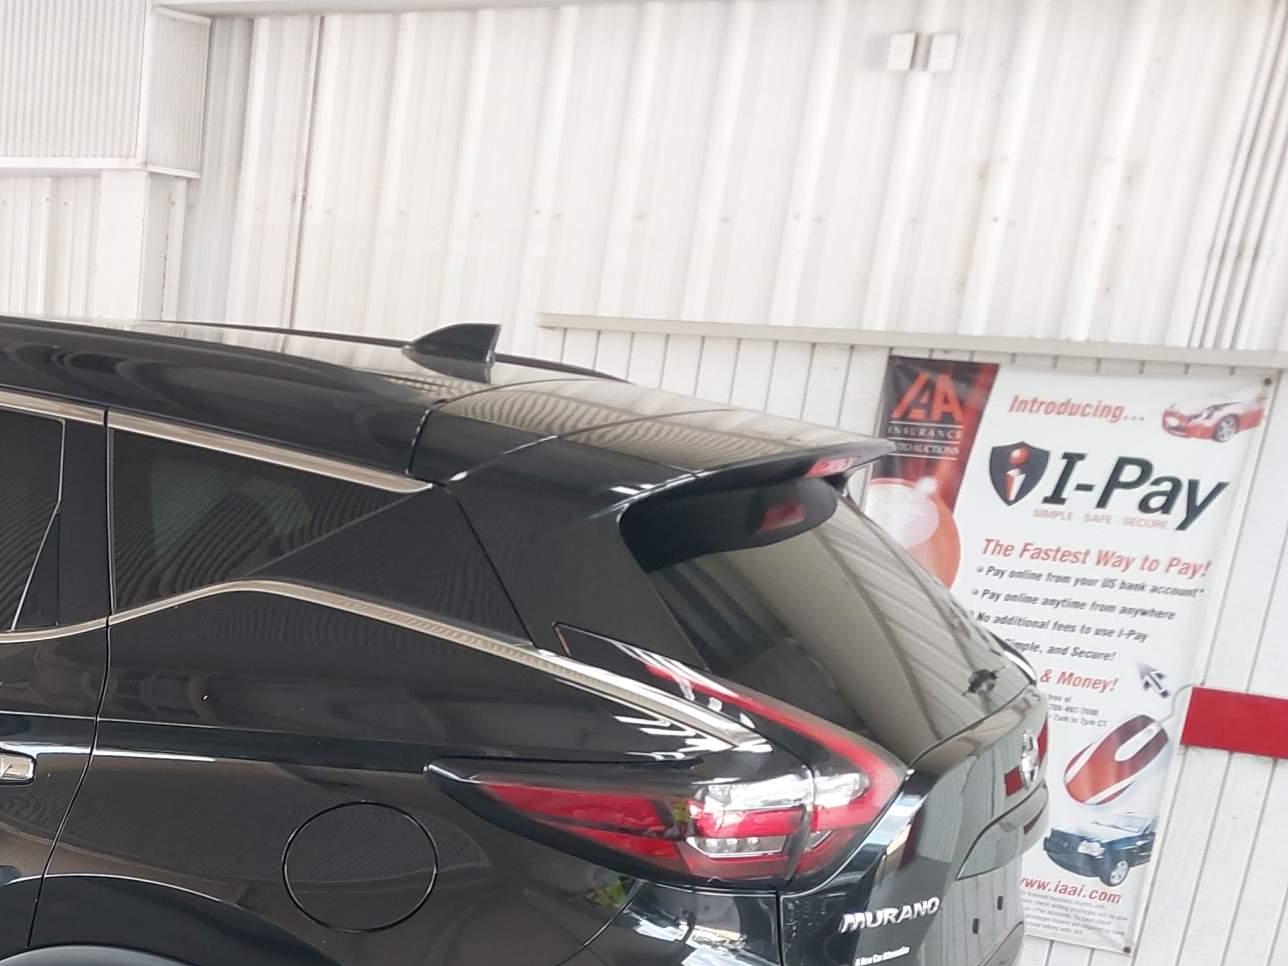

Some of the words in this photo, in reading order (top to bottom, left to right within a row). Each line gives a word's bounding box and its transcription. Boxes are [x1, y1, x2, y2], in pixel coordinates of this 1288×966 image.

[1008, 395, 1145, 423] Introducing...
[888, 425, 962, 439] INSURANCE
[914, 444, 960, 456] AUCTIONS
[1042, 452, 1231, 531] I-Pay
[982, 538, 1014, 558] The
[1018, 542, 1090, 565] Fastest
[1095, 550, 1135, 573] Way
[1140, 555, 1160, 572] to
[1165, 557, 1212, 580] Pay!
[986, 566, 1007, 579] Pay
[1009, 570, 1043, 581] online
[1046, 572, 1071, 583] from
[1072, 576, 1098, 587] your
[1101, 578, 1117, 588] US
[1118, 580, 1146, 591] bank
[981, 588, 1002, 602] Pay
[1004, 593, 1039, 604] online
[1041, 597, 1087, 609] anytime
[1089, 601, 1116, 612] from
[1119, 606, 1176, 620] anywhere
[976, 612, 991, 622] No
[992, 615, 1051, 629] additional
[1052, 620, 1077, 632] fees
[1080, 623, 1092, 634] to
[1094, 627, 1115, 637] use
[1117, 628, 1149, 643] I-Pay
[1046, 645, 1069, 655] and
[1070, 646, 1117, 661] Secure!
[1039, 669, 1053, 683] &
[1057, 671, 1120, 693] Money!
[838, 896, 941, 934] MURANO
